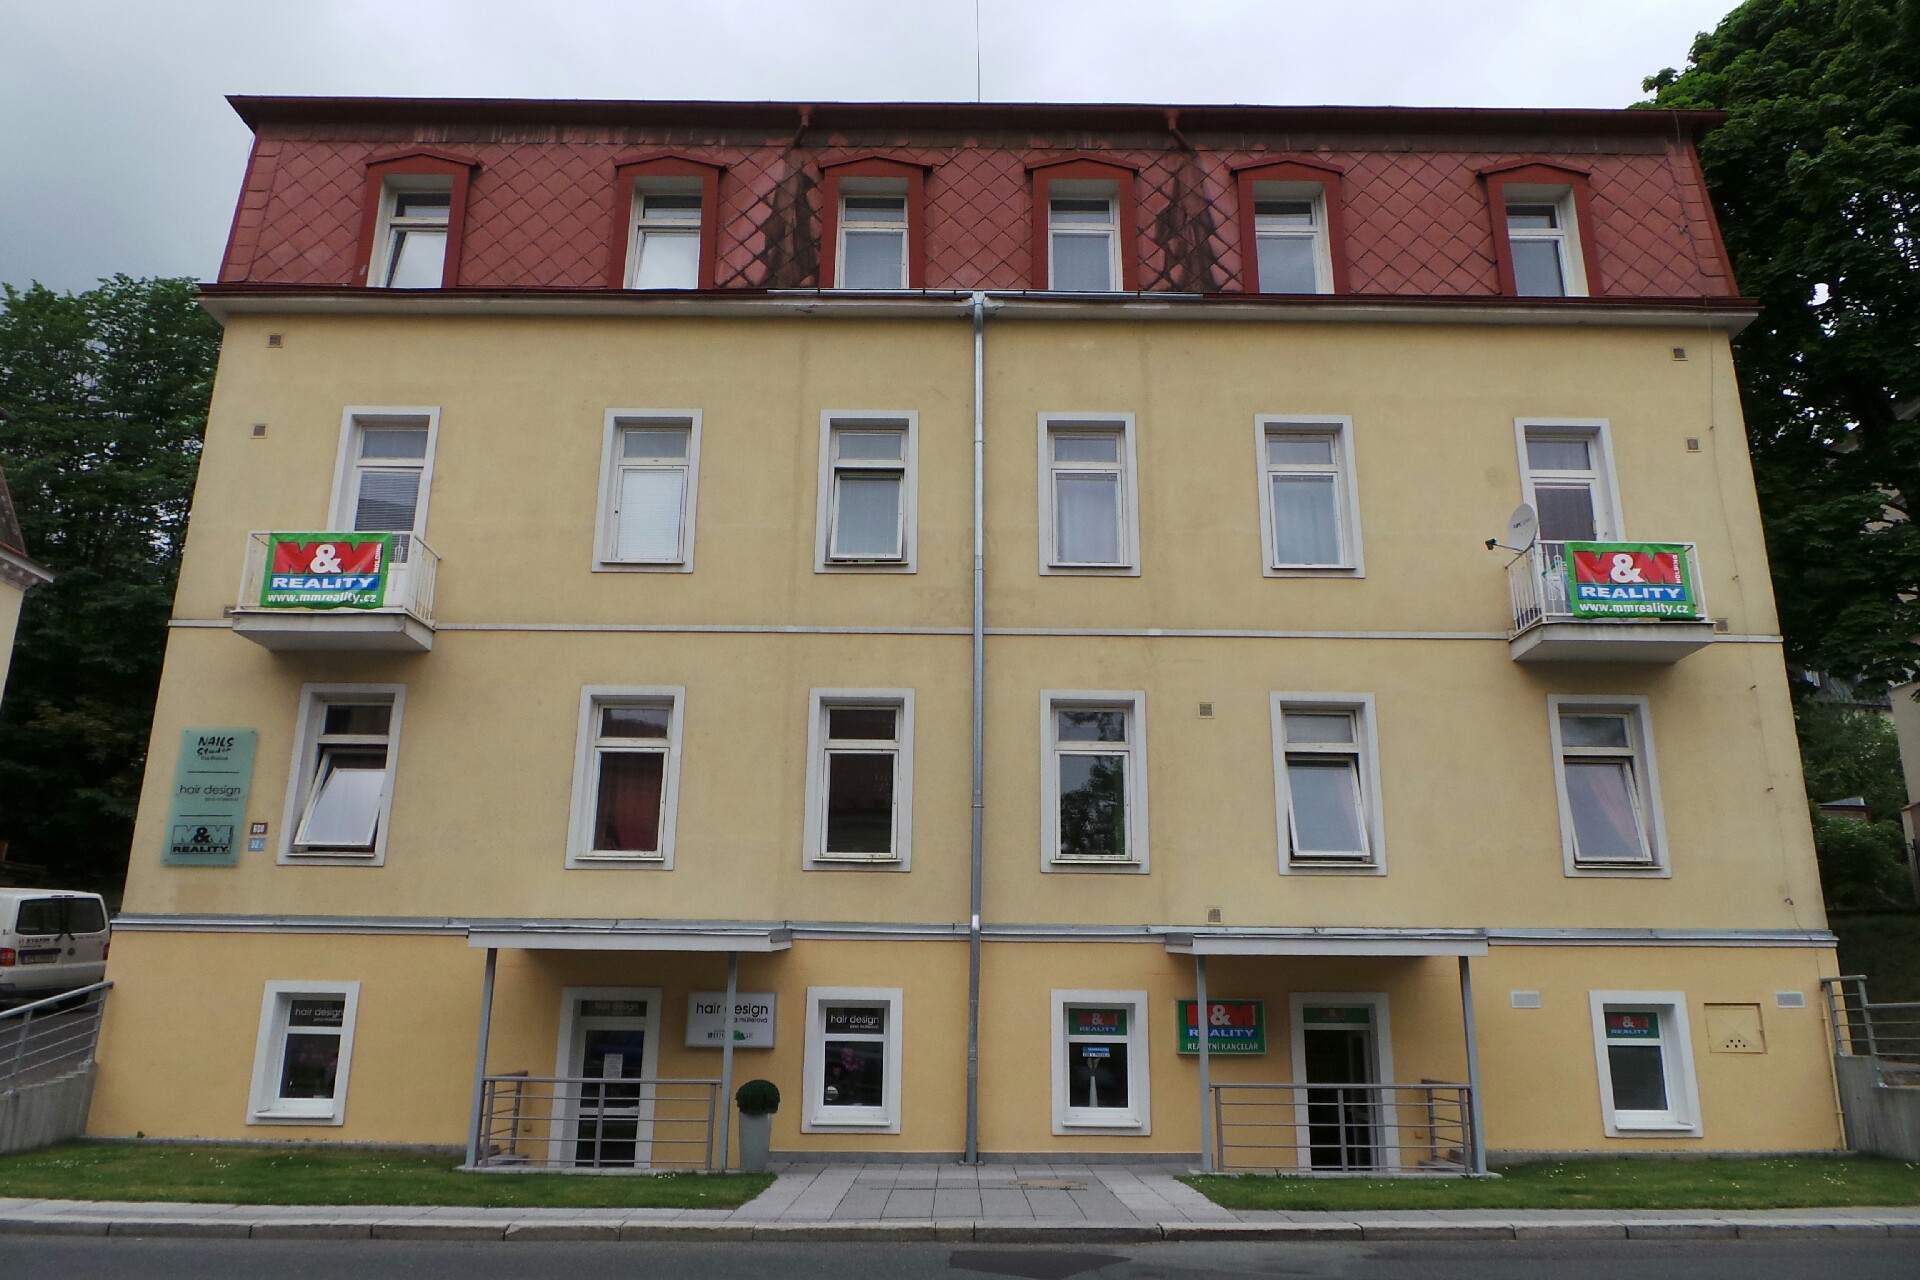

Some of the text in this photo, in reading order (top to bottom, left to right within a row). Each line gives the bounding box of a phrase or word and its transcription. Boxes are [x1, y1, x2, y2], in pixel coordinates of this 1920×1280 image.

[272, 542, 374, 573] M&M
[1574, 551, 1676, 584] M&M
[1672, 554, 1682, 584] HOLDING
[272, 577, 374, 589] REALITY
[267, 592, 377, 604] www.mmreality.cz
[1581, 586, 1681, 599] REALITY
[1579, 602, 1689, 616] www.mmreality.cz
[198, 736, 234, 747] NAILS
[180, 785, 241, 797] hair design
[696, 1003, 769, 1018] hair esign
[830, 1015, 879, 1025] hair design
[1189, 1029, 1255, 1037] RALITY
[1187, 1042, 1220, 1050] REATNÍ
